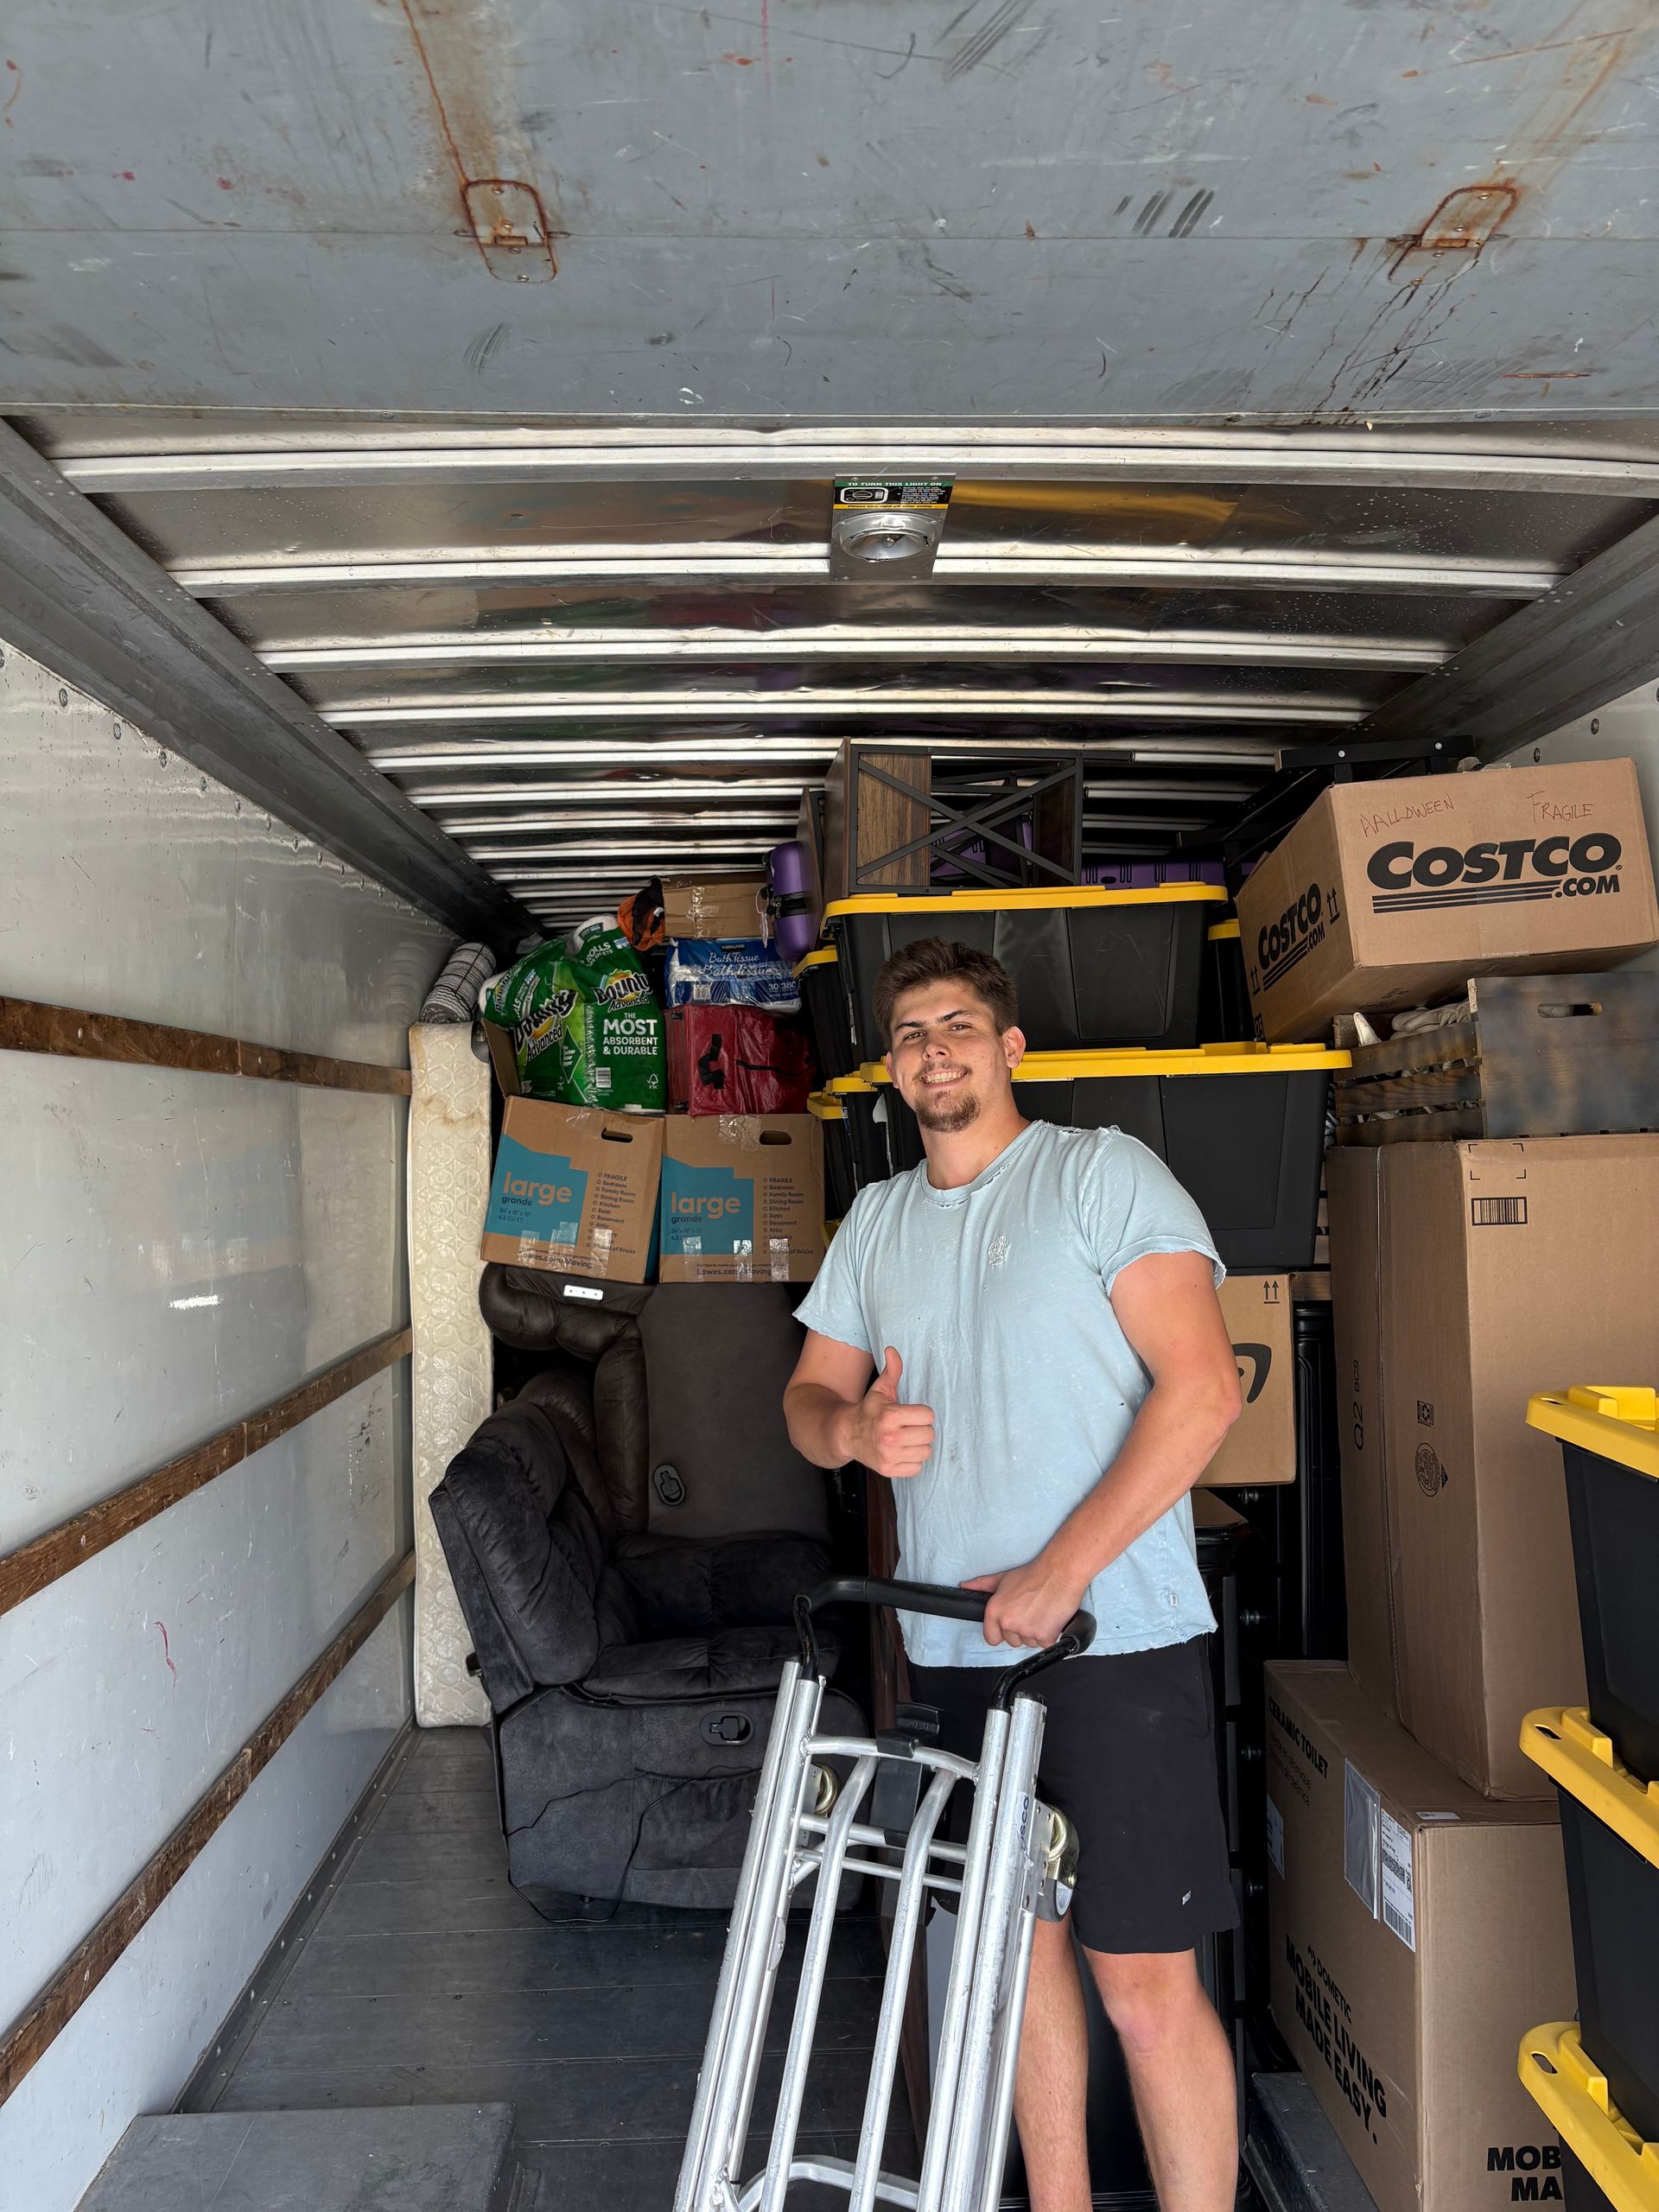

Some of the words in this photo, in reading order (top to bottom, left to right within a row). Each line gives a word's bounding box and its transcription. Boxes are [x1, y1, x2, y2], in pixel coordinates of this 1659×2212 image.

[1525, 790, 1594, 823] FRAGILE
[1367, 832, 1622, 890] COSTCO
[1555, 874, 1620, 898] .COM
[1258, 883, 1321, 970] COSTCO
[1307, 922, 1325, 953] .COM
[586, 942, 611, 963] ROLLS
[709, 952, 732, 963] Bath
[733, 952, 760, 963] Tissue
[703, 964, 734, 977] Bath
[735, 964, 773, 977] Tissue
[592, 972, 652, 1005] Bounty
[607, 995, 650, 1013] Advanced
[603, 1019, 658, 1035] MOST
[527, 1020, 563, 1060] Advanced
[603, 1037, 658, 1046] ABSORBENT
[603, 1046, 611, 1055] &
[613, 1046, 658, 1055] DURABLE
[503, 1172, 572, 1205] large
[603, 1173, 627, 1181] FRAGILE
[603, 1180, 627, 1189] Bedroom
[501, 1196, 533, 1207] grande
[599, 1201, 620, 1210] Kitchen
[671, 1192, 741, 1219] large
[597, 1215, 625, 1224] Basement
[671, 1215, 702, 1224] grande
[1353, 1402, 1364, 1451] Q2
[1268, 1696, 1300, 1746] CERAMIC
[1300, 1733, 1328, 1779] TOILET
[1317, 1957, 1352, 2024] DOMETIC
[1286, 1933, 1332, 2034] MOBILE
[1333, 2012, 1387, 2119] LIVING
[1295, 1984, 1332, 2071] MADE
[1487, 2145, 1561, 2171] MOB
[1511, 2177, 1563, 2201] MA
